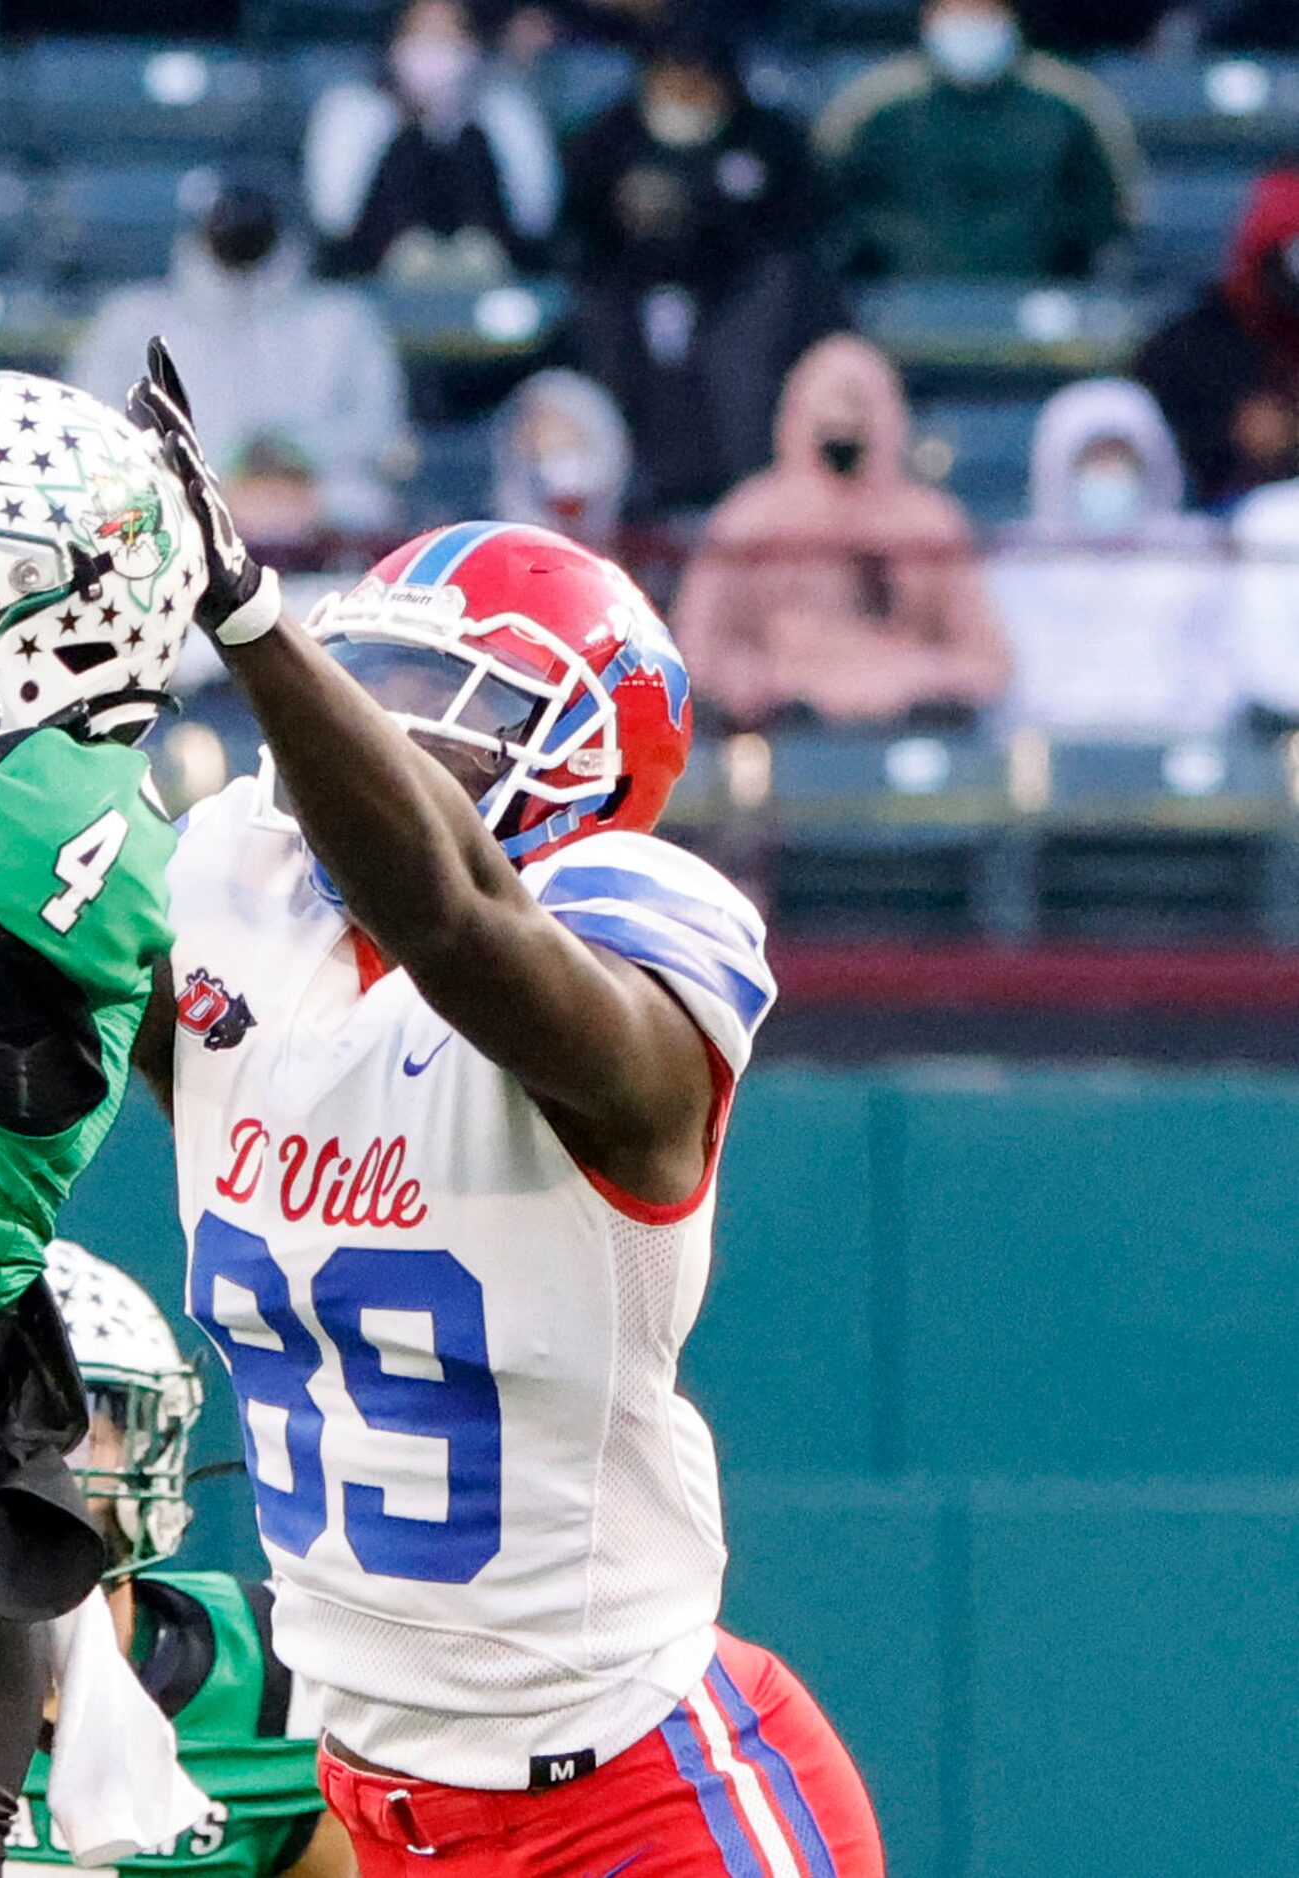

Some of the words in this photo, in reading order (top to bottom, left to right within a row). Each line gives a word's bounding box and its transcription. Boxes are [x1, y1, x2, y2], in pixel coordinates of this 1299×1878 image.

[38, 807, 130, 937] 4
[191, 1208, 501, 1584] 89
[550, 1759, 575, 1782] M
